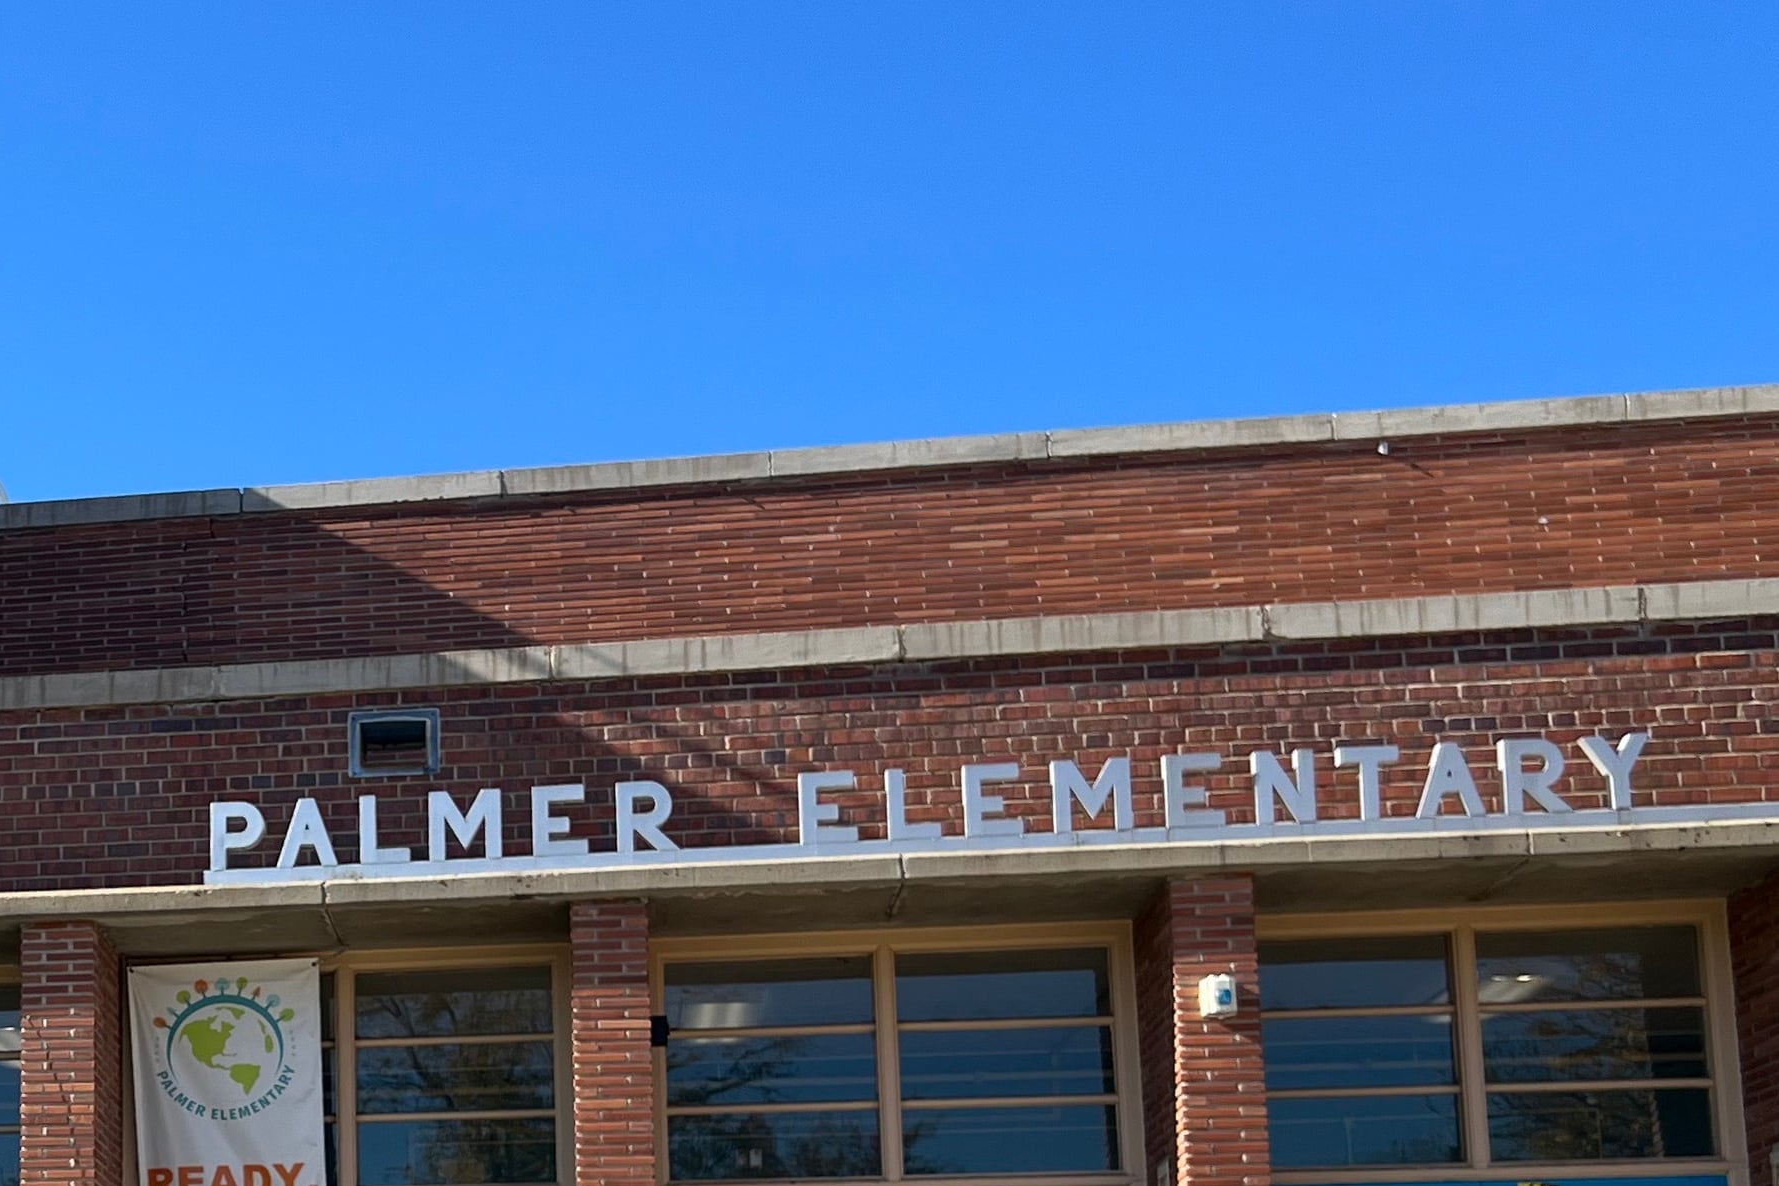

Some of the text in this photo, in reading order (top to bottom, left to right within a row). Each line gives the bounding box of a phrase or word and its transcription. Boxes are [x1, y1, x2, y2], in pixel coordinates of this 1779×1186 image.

[209, 731, 1652, 872] PALMER ELEMENTARY
[157, 1064, 295, 1120] PALMER ELEMENTARY
